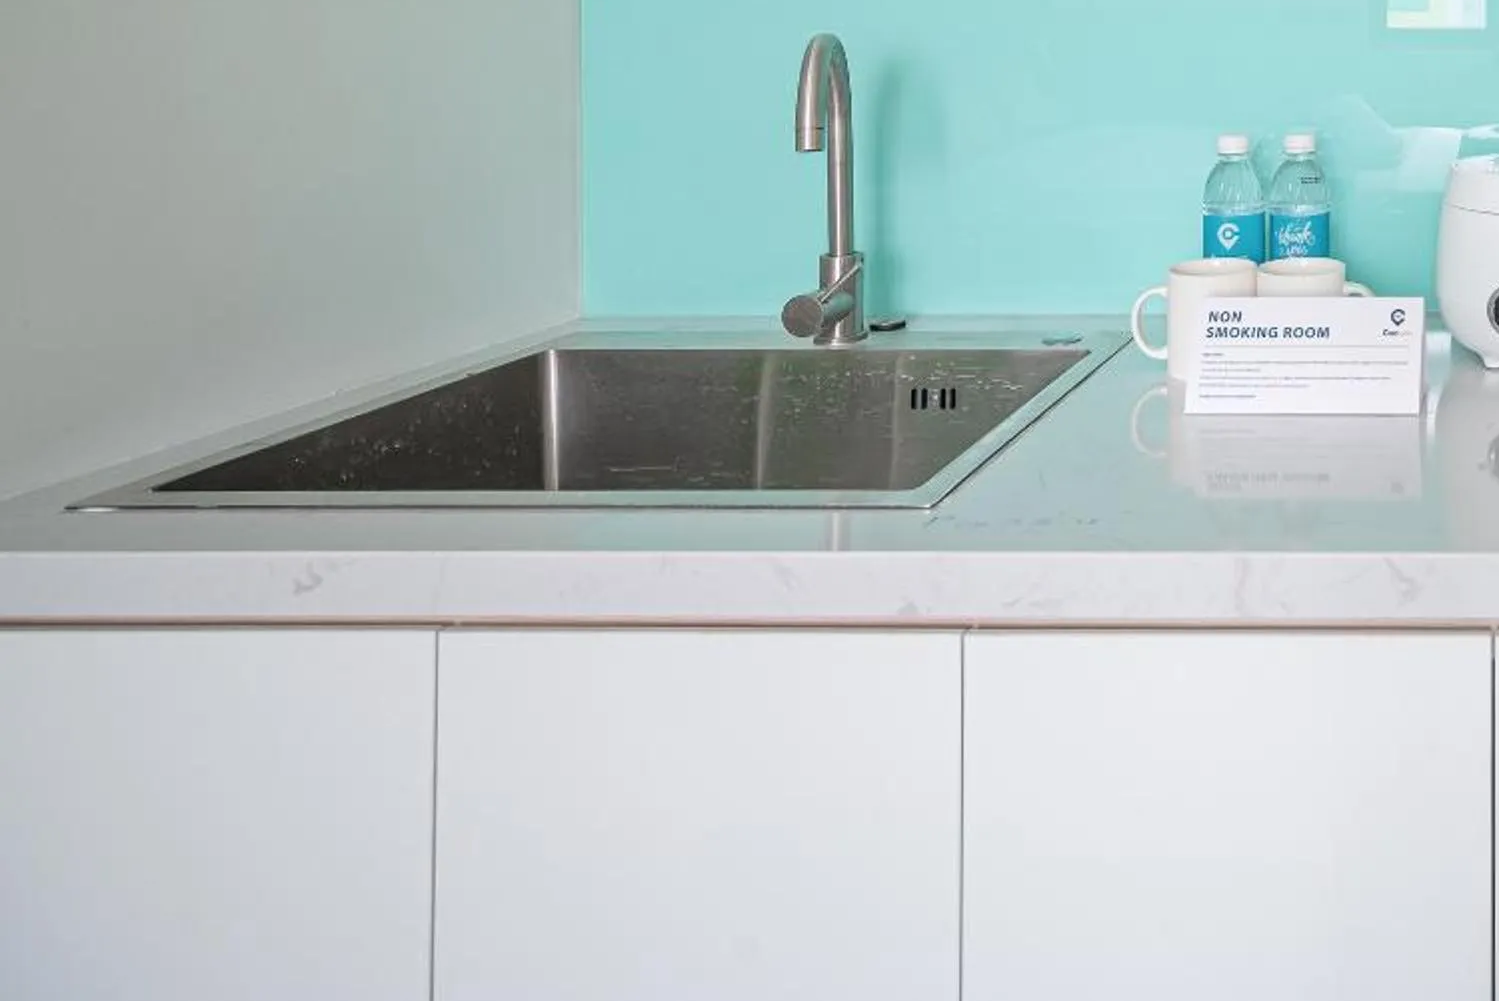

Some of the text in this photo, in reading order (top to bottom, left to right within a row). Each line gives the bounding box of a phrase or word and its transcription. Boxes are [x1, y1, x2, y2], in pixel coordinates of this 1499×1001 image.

[1208, 311, 1242, 323] NON
[1206, 327, 1330, 339] SMOKING ROOM
